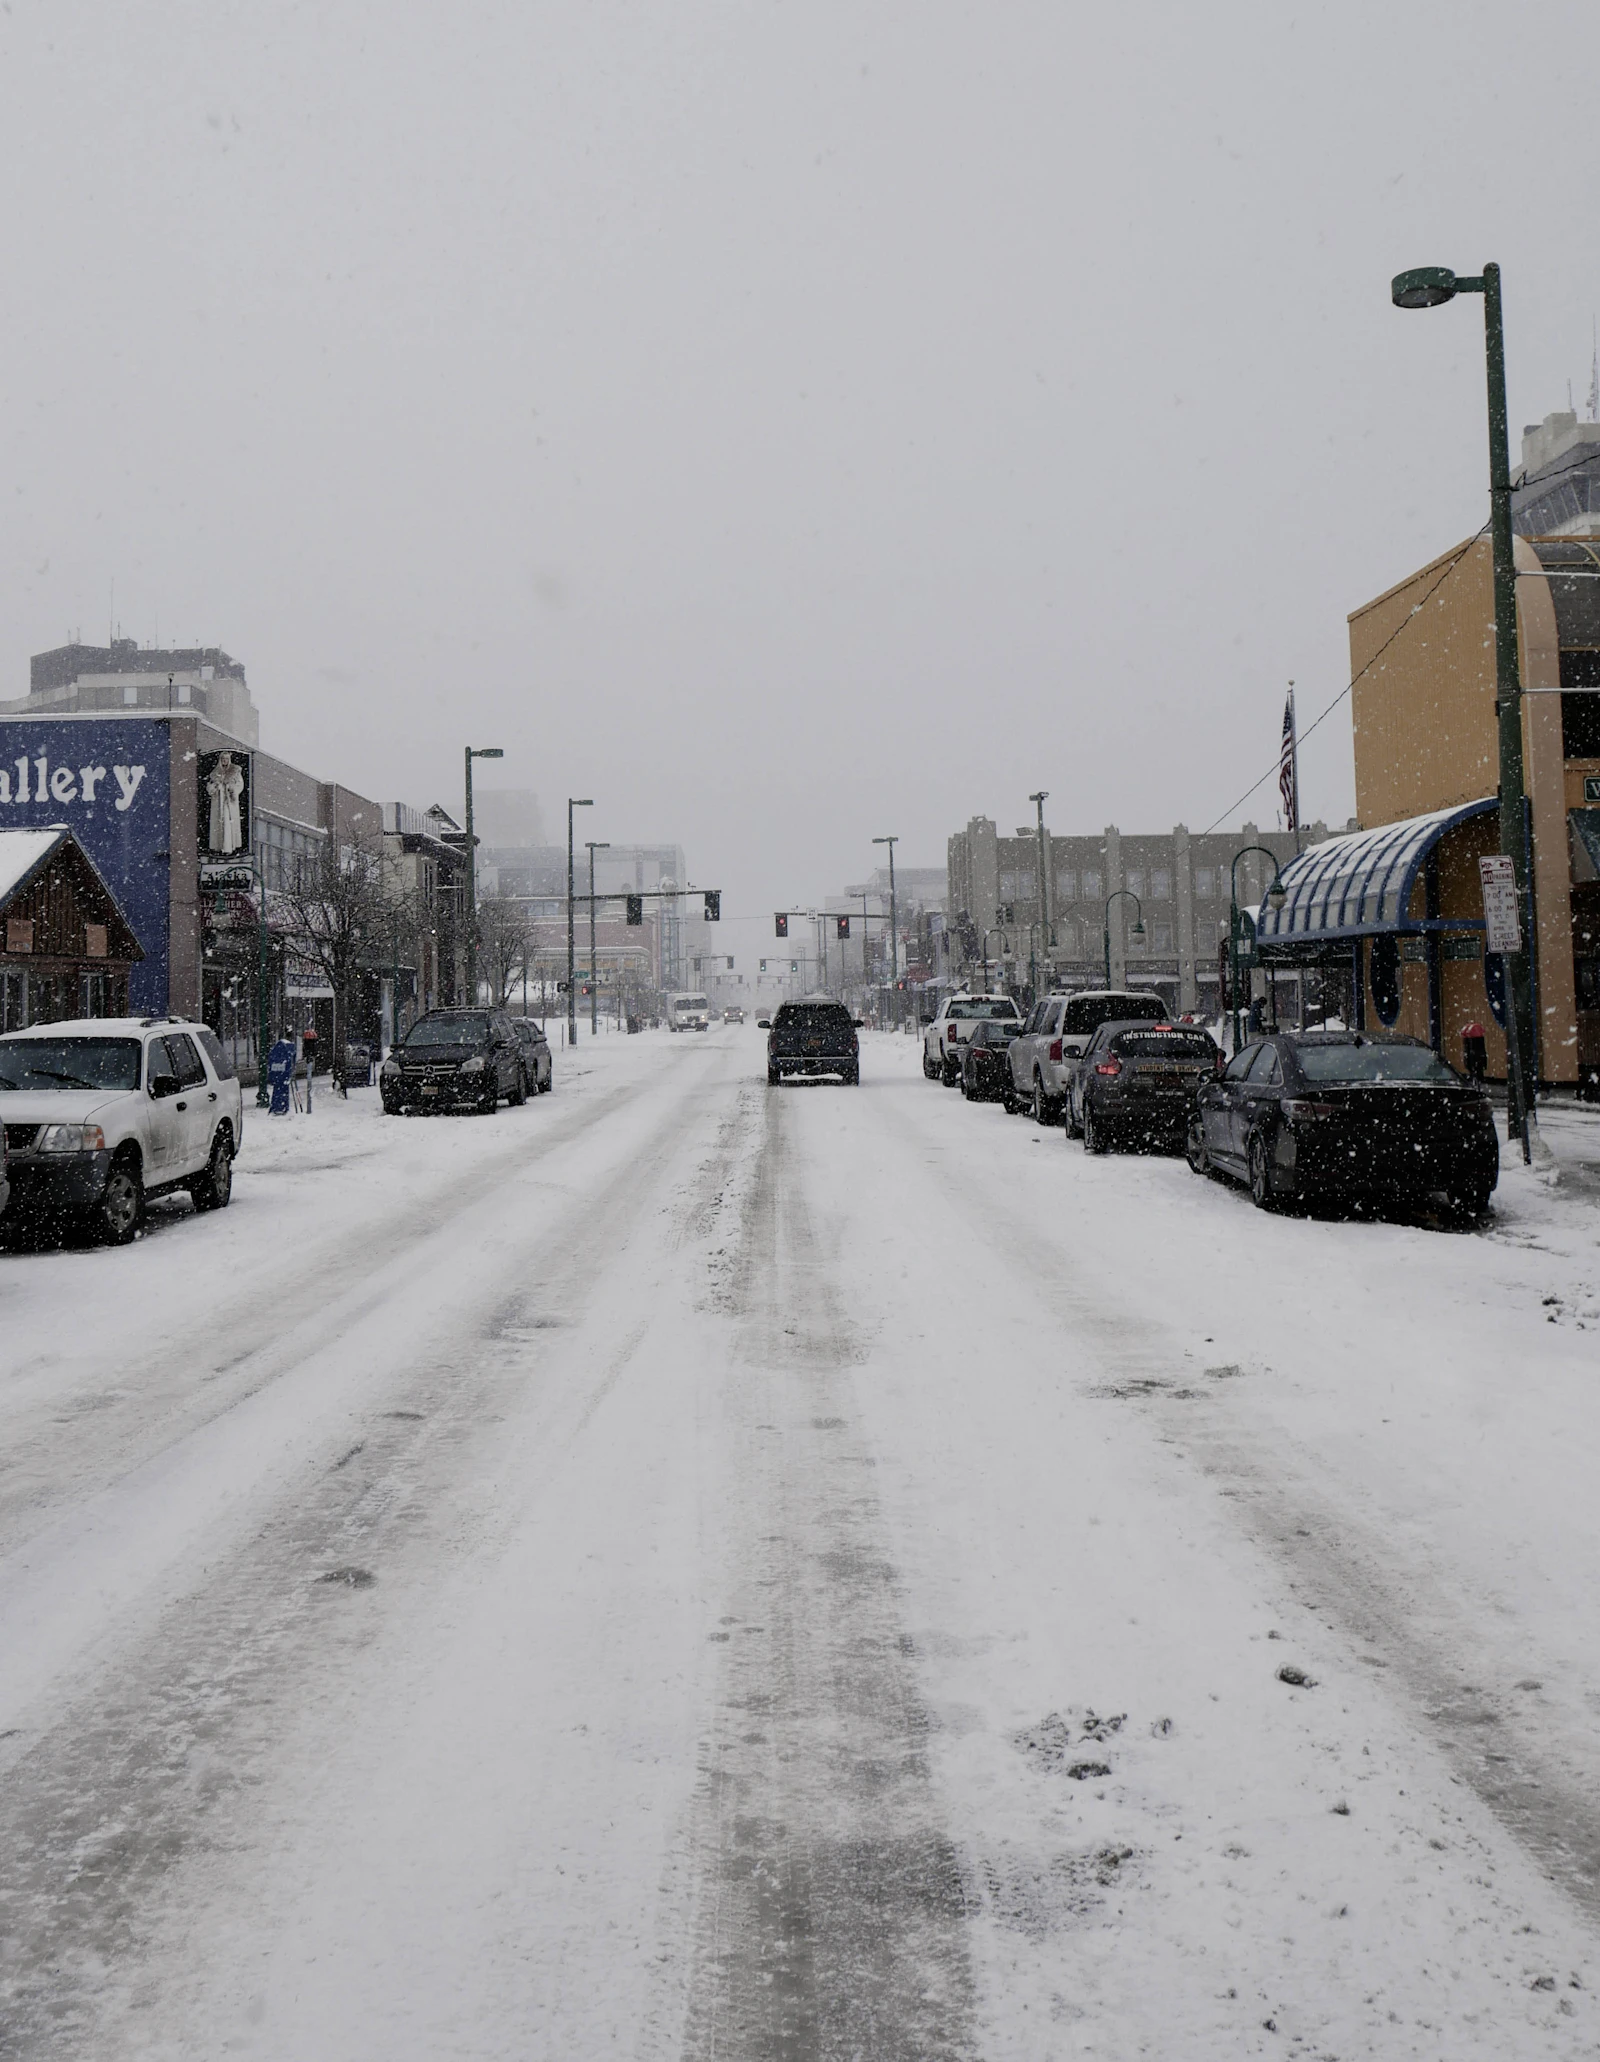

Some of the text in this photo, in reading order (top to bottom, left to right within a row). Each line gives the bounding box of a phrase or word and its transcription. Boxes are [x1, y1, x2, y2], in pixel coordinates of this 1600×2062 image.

[1483, 873, 1493, 882] NO
[1491, 940, 1518, 948] CLEANING
[1123, 1032, 1205, 1042] INSTRUCTION CAR
